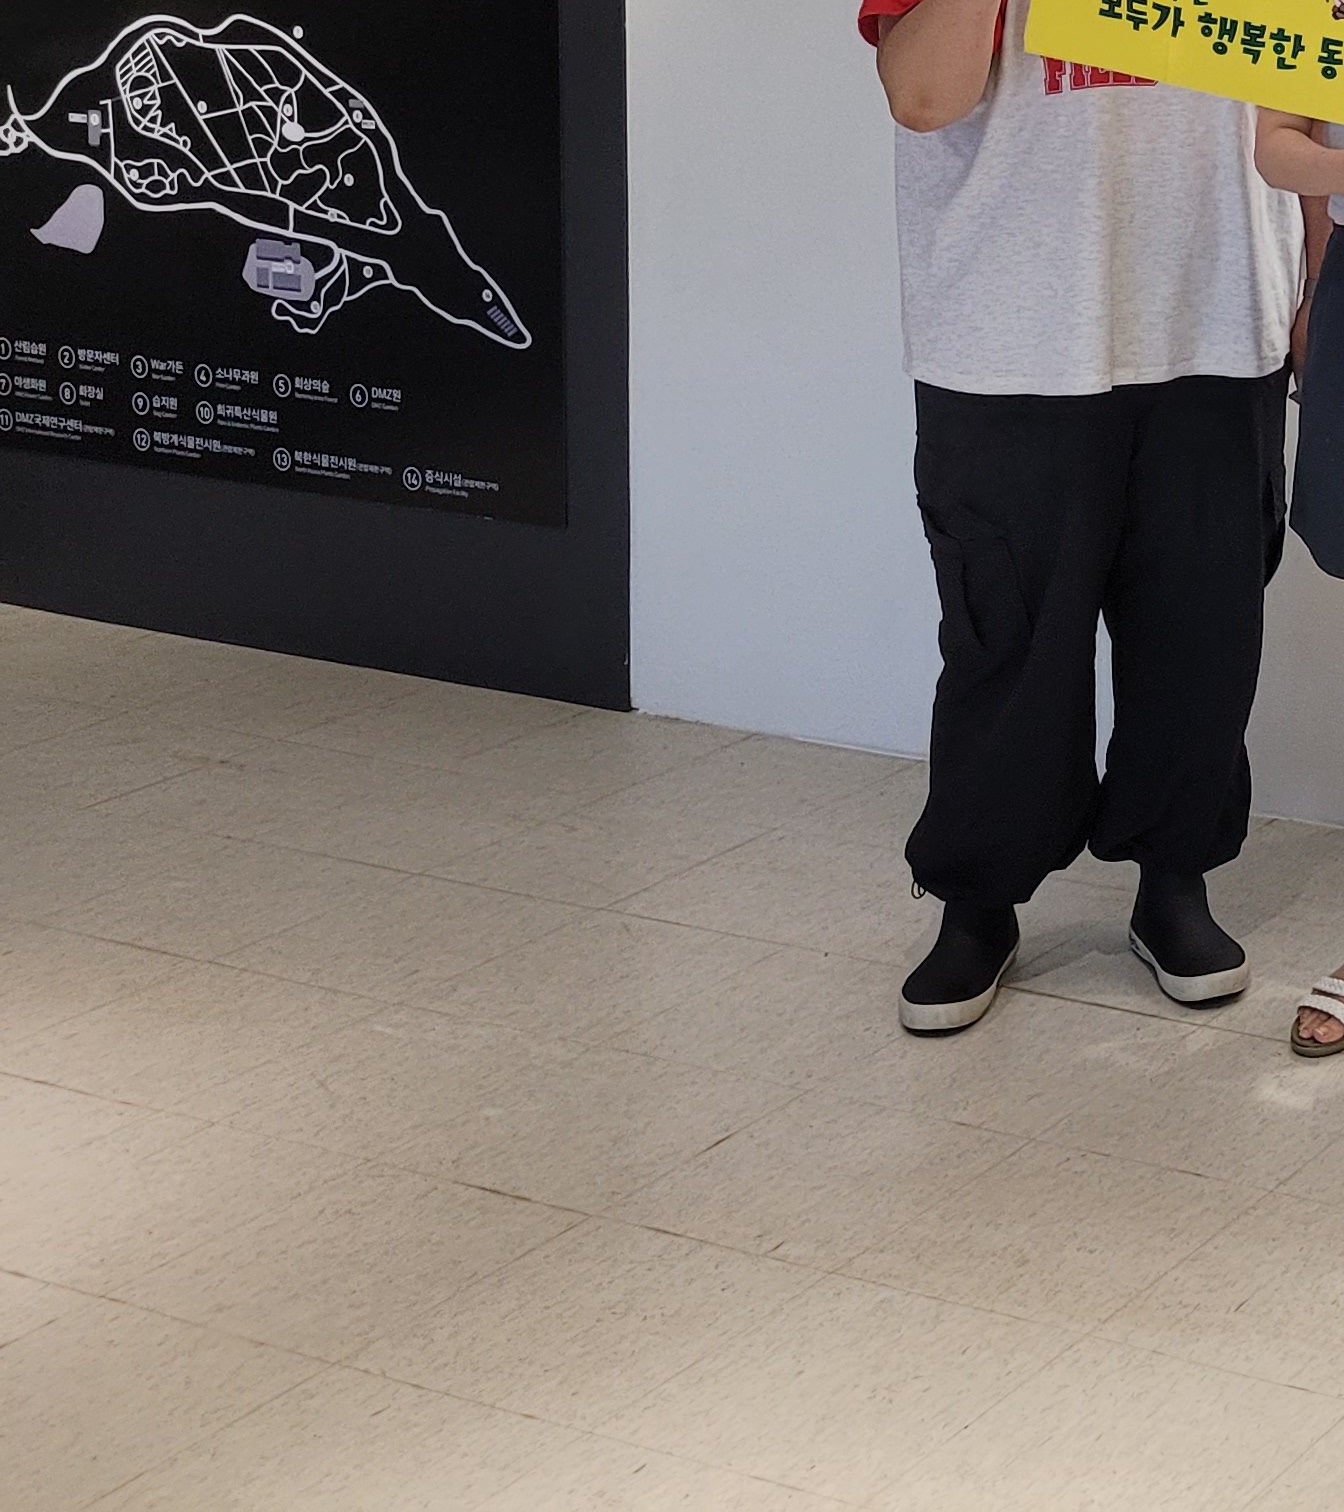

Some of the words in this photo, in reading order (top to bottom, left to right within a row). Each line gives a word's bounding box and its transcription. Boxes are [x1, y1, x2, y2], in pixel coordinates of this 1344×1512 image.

[1197, 11, 1306, 71] 행복한
[151, 358, 184, 374] War가든
[371, 387, 401, 402] DMZ원
[152, 395, 178, 410] 습지원
